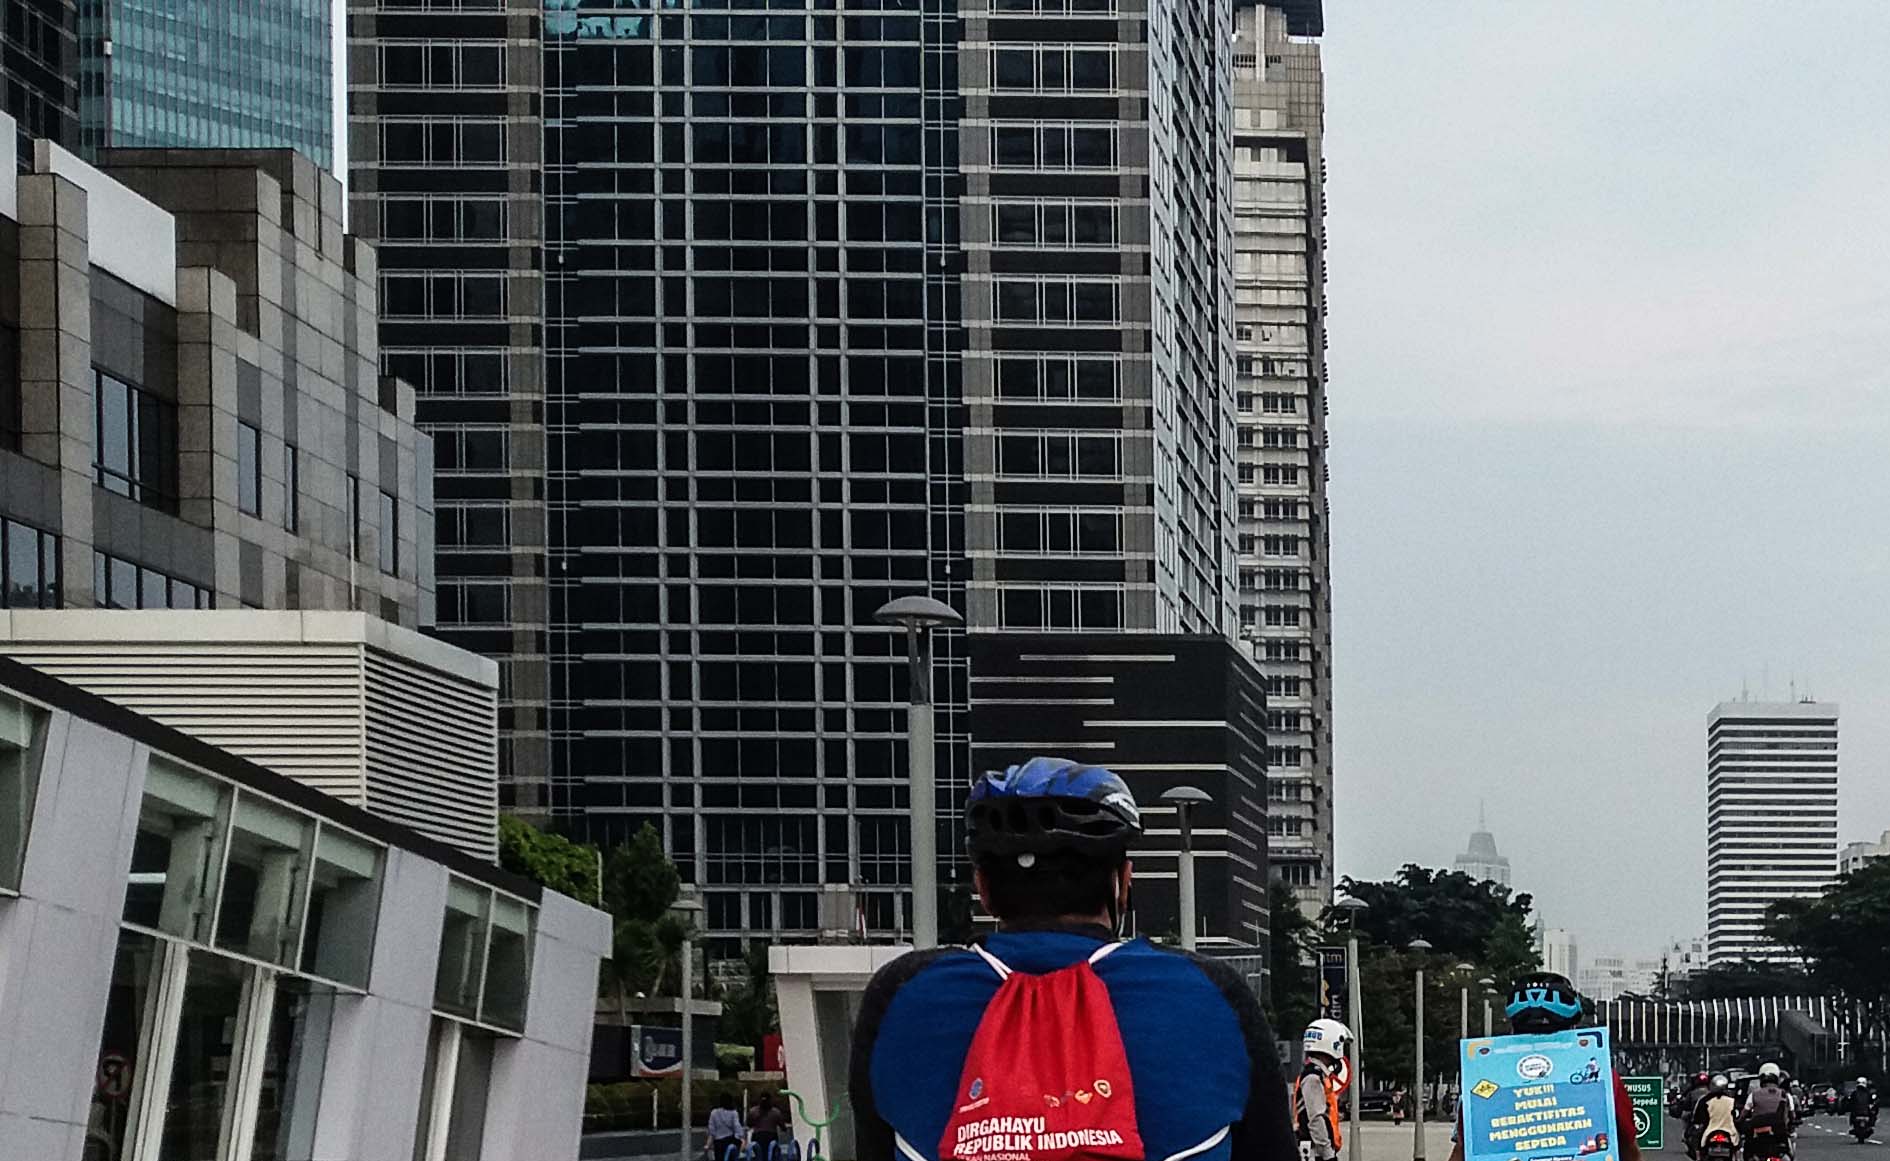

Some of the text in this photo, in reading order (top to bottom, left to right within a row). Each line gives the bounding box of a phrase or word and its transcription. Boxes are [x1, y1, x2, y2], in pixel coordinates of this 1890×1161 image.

[1514, 1097, 1558, 1111] MULAI
[957, 1116, 1046, 1143] DIRGAHAYU
[1488, 1118, 1593, 1142] MENGGUNAKAN
[953, 1128, 1124, 1156] REPUBLIK INDONESIA
[1514, 1136, 1567, 1152] SEPEDA
[983, 1152, 1032, 1161] NASIONAL
